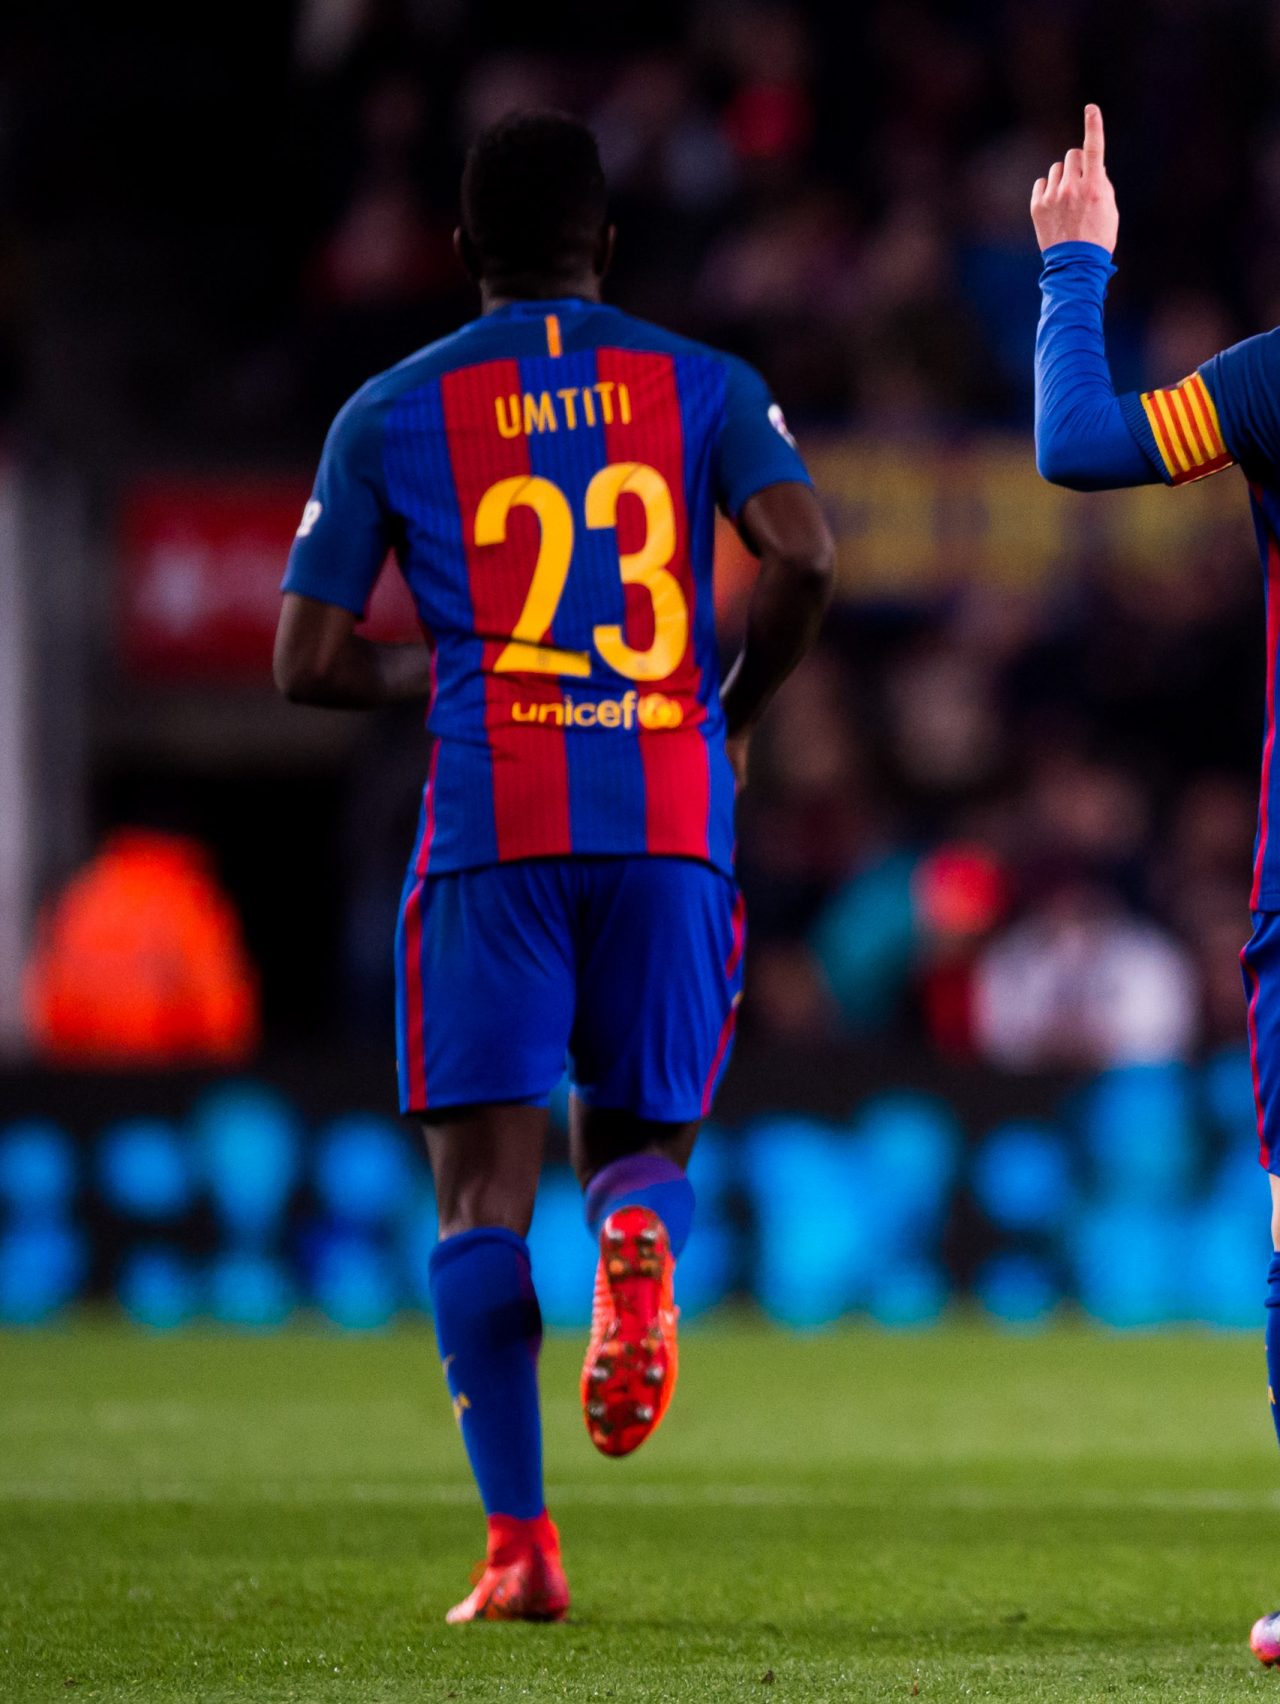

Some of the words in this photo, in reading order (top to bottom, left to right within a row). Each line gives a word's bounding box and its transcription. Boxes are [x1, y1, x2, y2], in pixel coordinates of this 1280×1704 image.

[494, 381, 632, 439] UMTITI
[473, 461, 689, 682] 23
[510, 690, 638, 730] unicef
